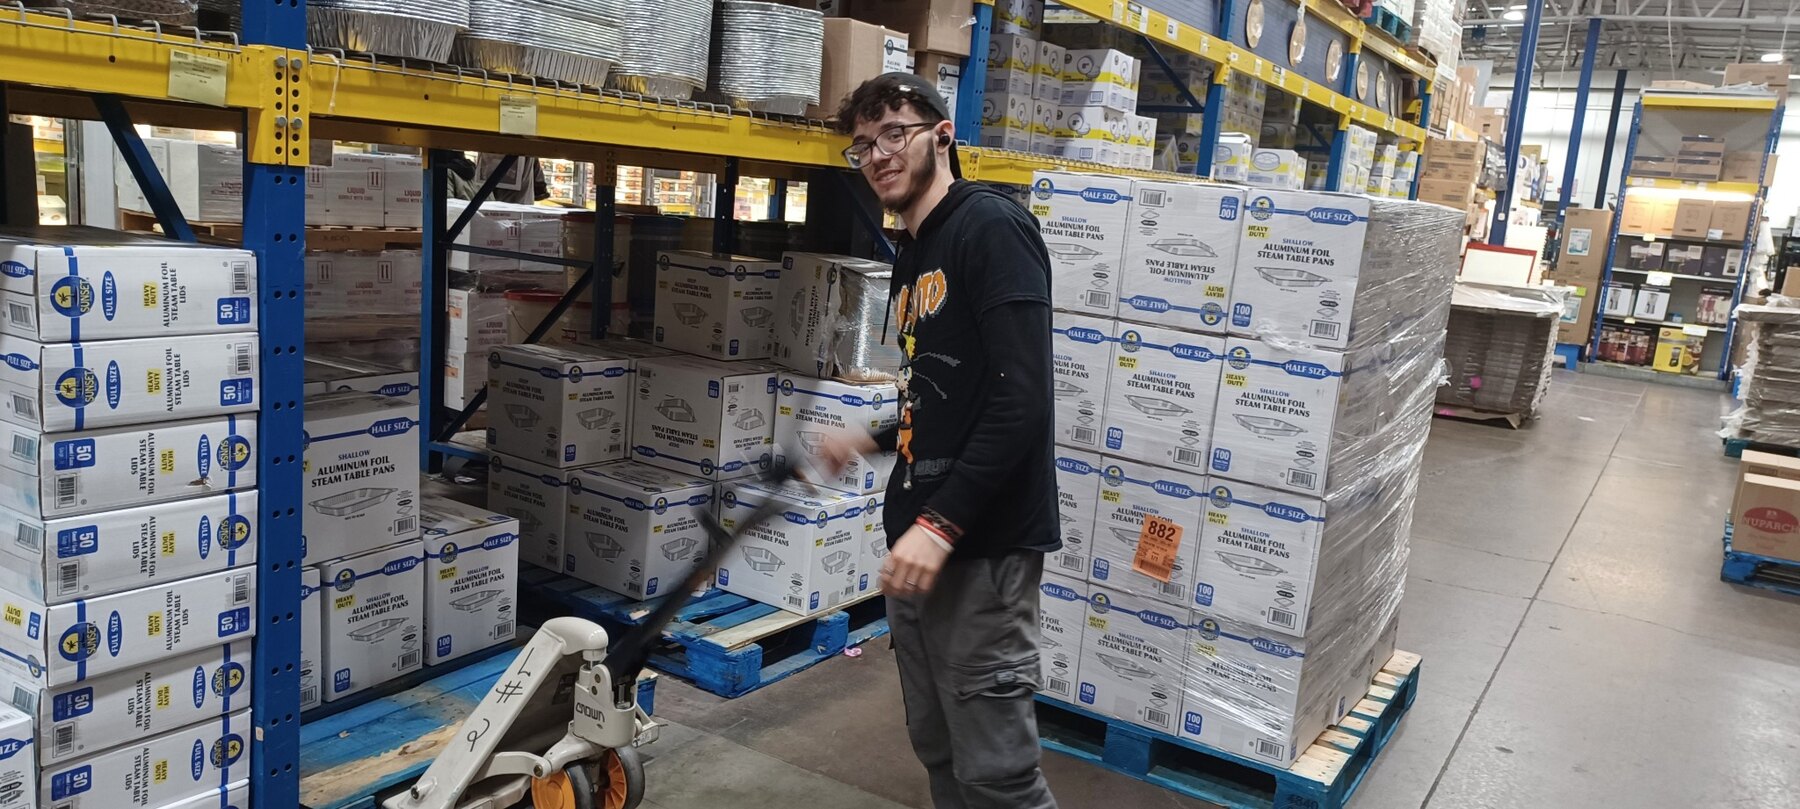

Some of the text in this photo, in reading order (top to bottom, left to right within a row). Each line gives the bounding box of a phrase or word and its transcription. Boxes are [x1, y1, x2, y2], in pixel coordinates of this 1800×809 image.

[1083, 191, 1118, 200] HALF SIZE
[1221, 209, 1235, 218] 100
[1310, 211, 1353, 222] HALF SIZE
[1041, 228, 1104, 240] STEAM TABLE PANS
[1046, 221, 1100, 232] ALUMINUM FOIL
[1263, 244, 1330, 257] ALUMINUM FOIL
[1146, 258, 1215, 273] STEAM TABLE PANS
[1257, 251, 1335, 266] STEAM TABLE PANS
[1, 264, 26, 275] FULL SIZE
[1150, 267, 1209, 280] ALUMINUM FOIL
[105, 276, 113, 293] SIZE
[80, 278, 91, 313] SUNSET
[221, 305, 233, 318] 50
[1133, 299, 1168, 309] HALF SIZE
[1235, 305, 1250, 315] 100
[1172, 346, 1212, 359] HALF SIZE
[7, 356, 31, 368] FULL SIZE
[1285, 363, 1327, 376] HALF SIZE
[109, 366, 117, 385] SIZE
[1132, 373, 1191, 390] ALUMINUM FOIL
[1225, 373, 1245, 381] HEAVY
[84, 370, 96, 404] SUNSET
[224, 386, 235, 400] 50
[1127, 380, 1195, 399] STEAM TABLE PANS
[1241, 392, 1306, 409] ALUMINUM FOIL
[800, 408, 842, 421] ALUMINUM FOIL
[1235, 399, 1310, 418] STEAM TABLE PANS
[372, 420, 410, 435] HALF SIZE
[795, 414, 846, 429] STEAM TABLE PANS
[1109, 429, 1121, 438] 100
[77, 445, 91, 461] 50
[220, 440, 229, 471] SUNSET
[338, 450, 370, 460] SHALLOW
[1215, 450, 1230, 460] 100
[318, 456, 390, 476] ALUMINUM FOIL
[312, 465, 395, 488] STEAM TABLE PANS
[1154, 483, 1192, 495] HALF SIZE
[1265, 505, 1306, 520] HALF SIZE
[1149, 521, 1175, 542] 882
[1217, 536, 1290, 559] STEAM TABLE PANS
[1223, 530, 1286, 550] ALUMINUM FOIL
[384, 558, 416, 574] HALF SIZE
[1198, 585, 1212, 595] 100
[348, 601, 409, 624] STEAM TABLE PANS
[352, 595, 405, 615] ALUMINUM FOIL
[1140, 612, 1176, 627] HALF SIZE
[87, 621, 96, 655] SUNSET
[1103, 634, 1159, 655] ALUMINUM FOIL
[1252, 640, 1273, 650] HALF
[1098, 639, 1162, 663] STEAM TABLE PANS
[336, 671, 349, 681] 100
[1082, 684, 1094, 693] 100
[575, 703, 605, 722] CROWN
[1187, 713, 1200, 724] 100
